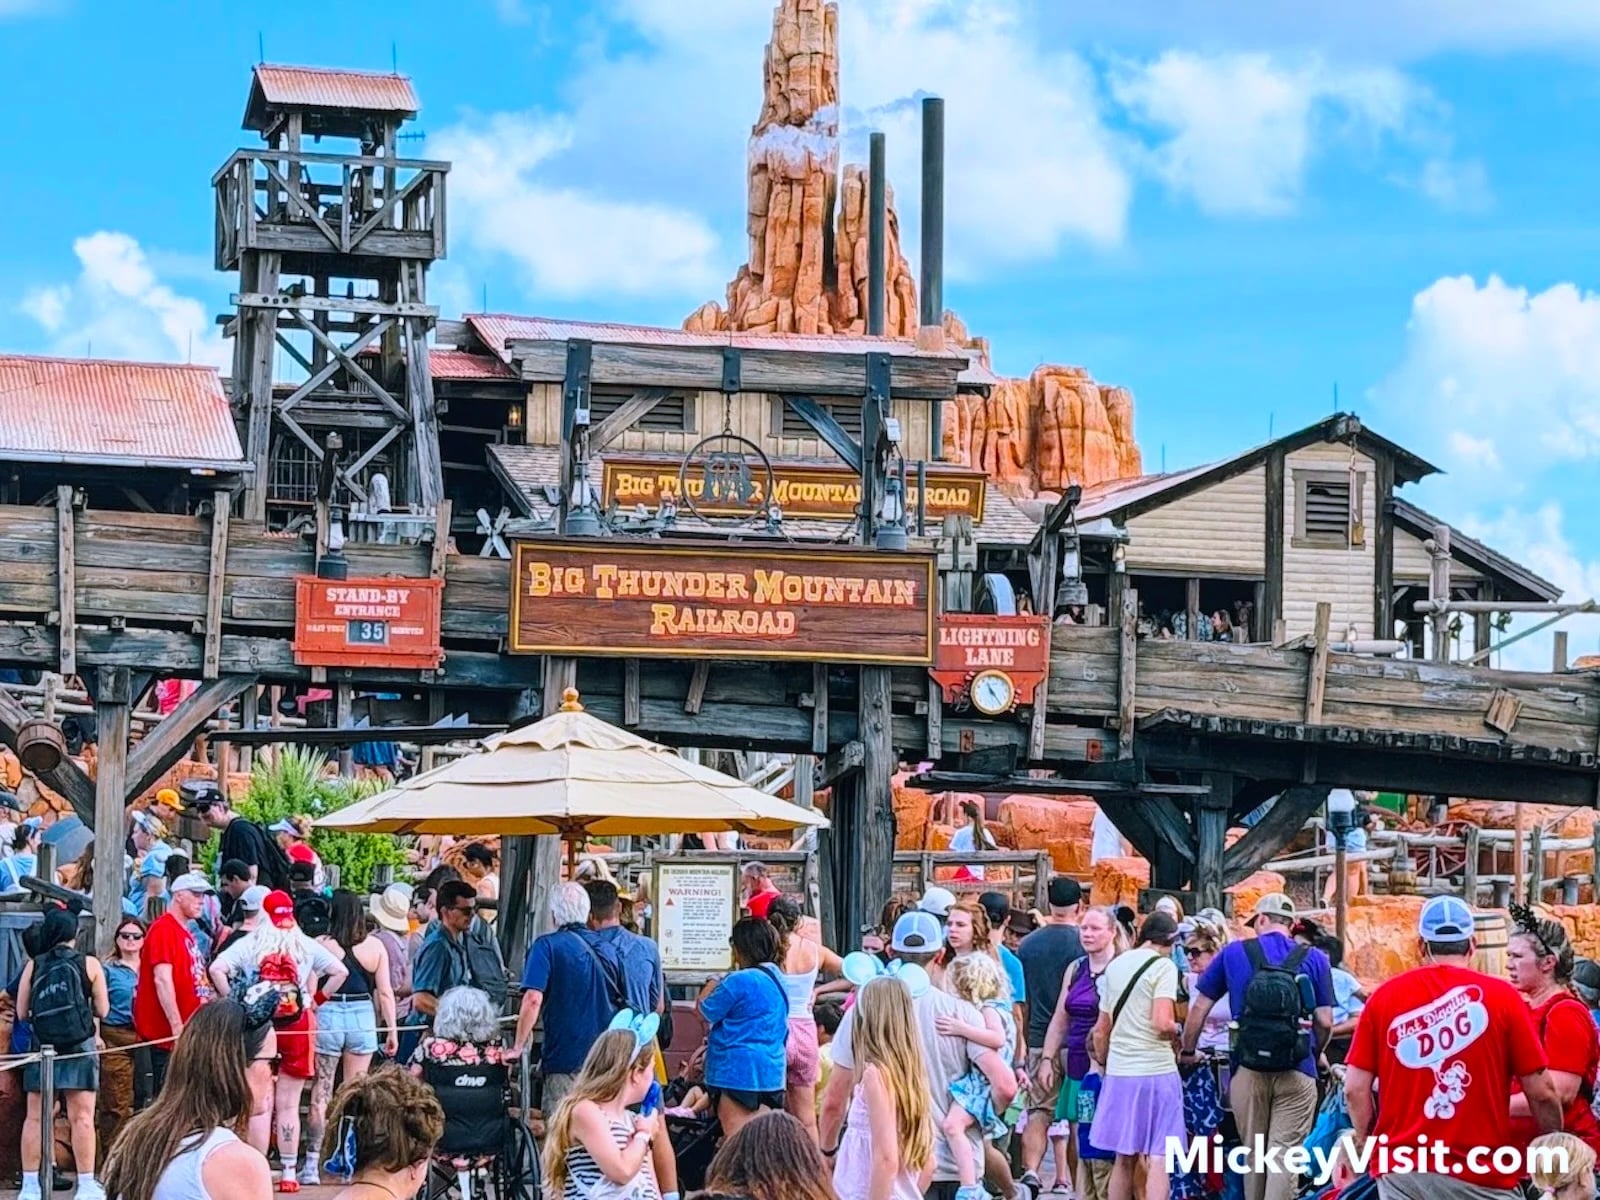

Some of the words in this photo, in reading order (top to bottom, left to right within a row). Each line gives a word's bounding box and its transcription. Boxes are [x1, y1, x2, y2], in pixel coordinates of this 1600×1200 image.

[615, 473, 655, 496] BIG
[528, 562, 585, 597] BIG
[592, 564, 749, 600] THUNDER
[753, 568, 916, 606] MOUNTAIN
[326, 587, 410, 604] STAND-BY
[334, 604, 400, 617] ENTRANCE
[649, 604, 796, 636] RAILROAD
[361, 622, 384, 640] 35
[939, 627, 1040, 646] LIGHTNING
[965, 648, 1014, 666] LANE
[668, 888, 721, 896] WARNING!
[1397, 1018, 1423, 1040] Hot
[1417, 1010, 1471, 1058] DOG
[455, 1074, 487, 1087] drive
